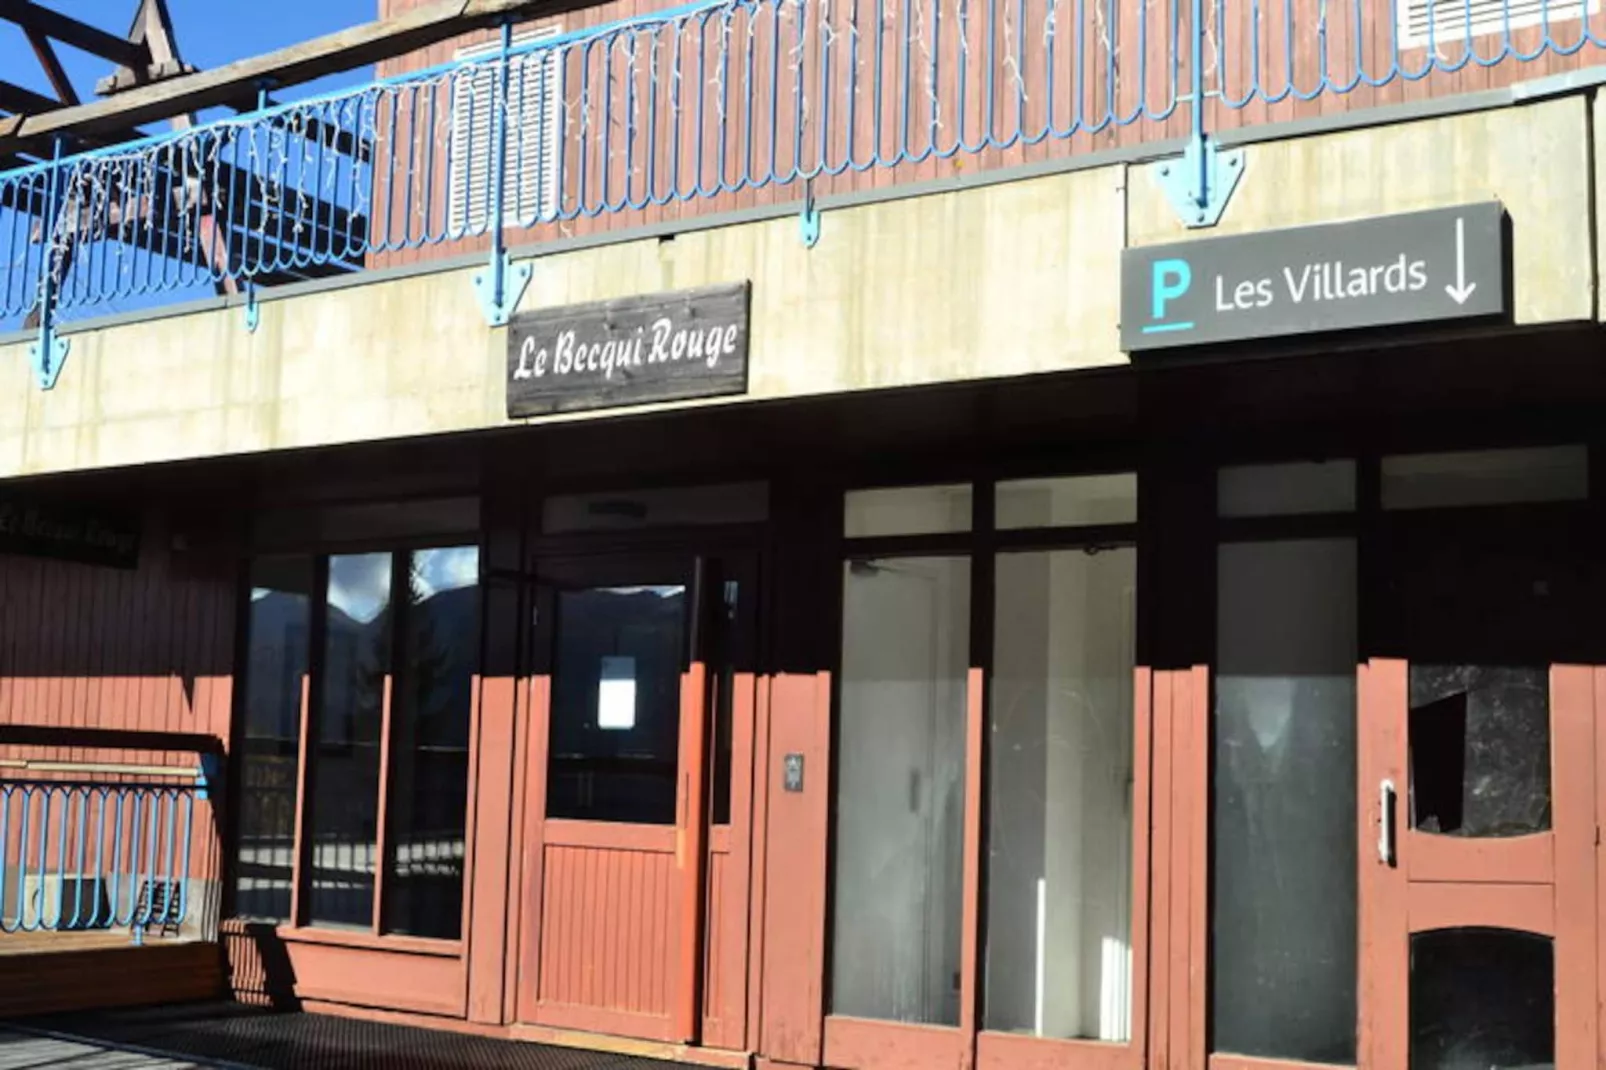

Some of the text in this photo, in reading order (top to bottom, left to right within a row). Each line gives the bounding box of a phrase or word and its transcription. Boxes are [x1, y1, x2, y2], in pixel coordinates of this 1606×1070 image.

[1152, 253, 1428, 319] P Les Villards
[514, 318, 738, 380] Le Becqui Rouge
